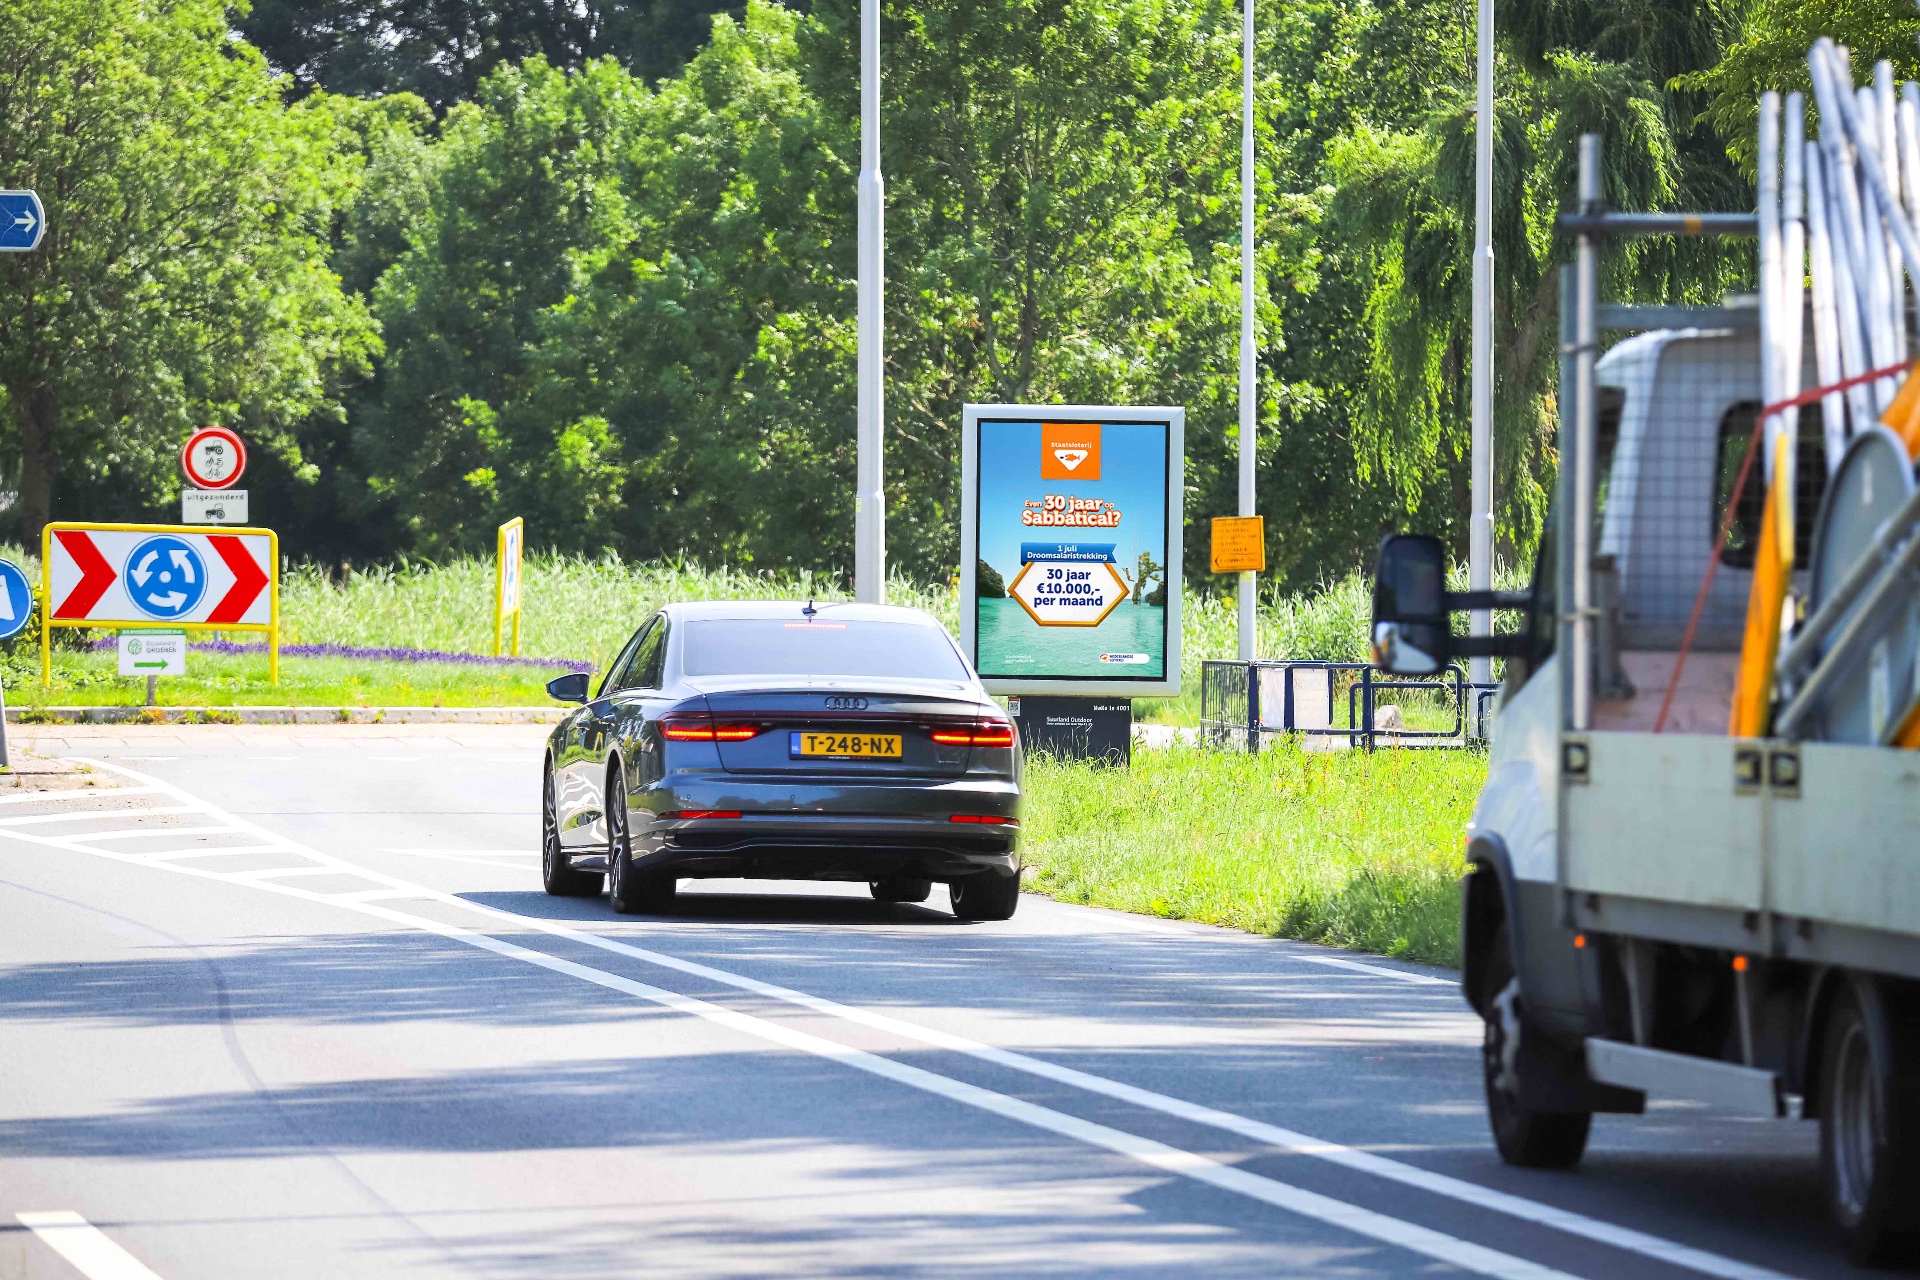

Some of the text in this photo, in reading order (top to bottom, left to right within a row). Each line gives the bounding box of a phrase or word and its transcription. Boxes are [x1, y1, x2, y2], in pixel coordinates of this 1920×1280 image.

[1051, 441, 1092, 449] Staatsloterij
[1025, 495, 1115, 514] Even 30 jaar op
[1022, 510, 1122, 527] Sabbatical?
[1064, 545, 1077, 553] juli
[1027, 552, 1108, 560] Droomsalaristrekking
[1047, 568, 1091, 582] 30 jaar
[1034, 595, 1103, 608] per maand
[807, 735, 895, 755] T-248-NX
